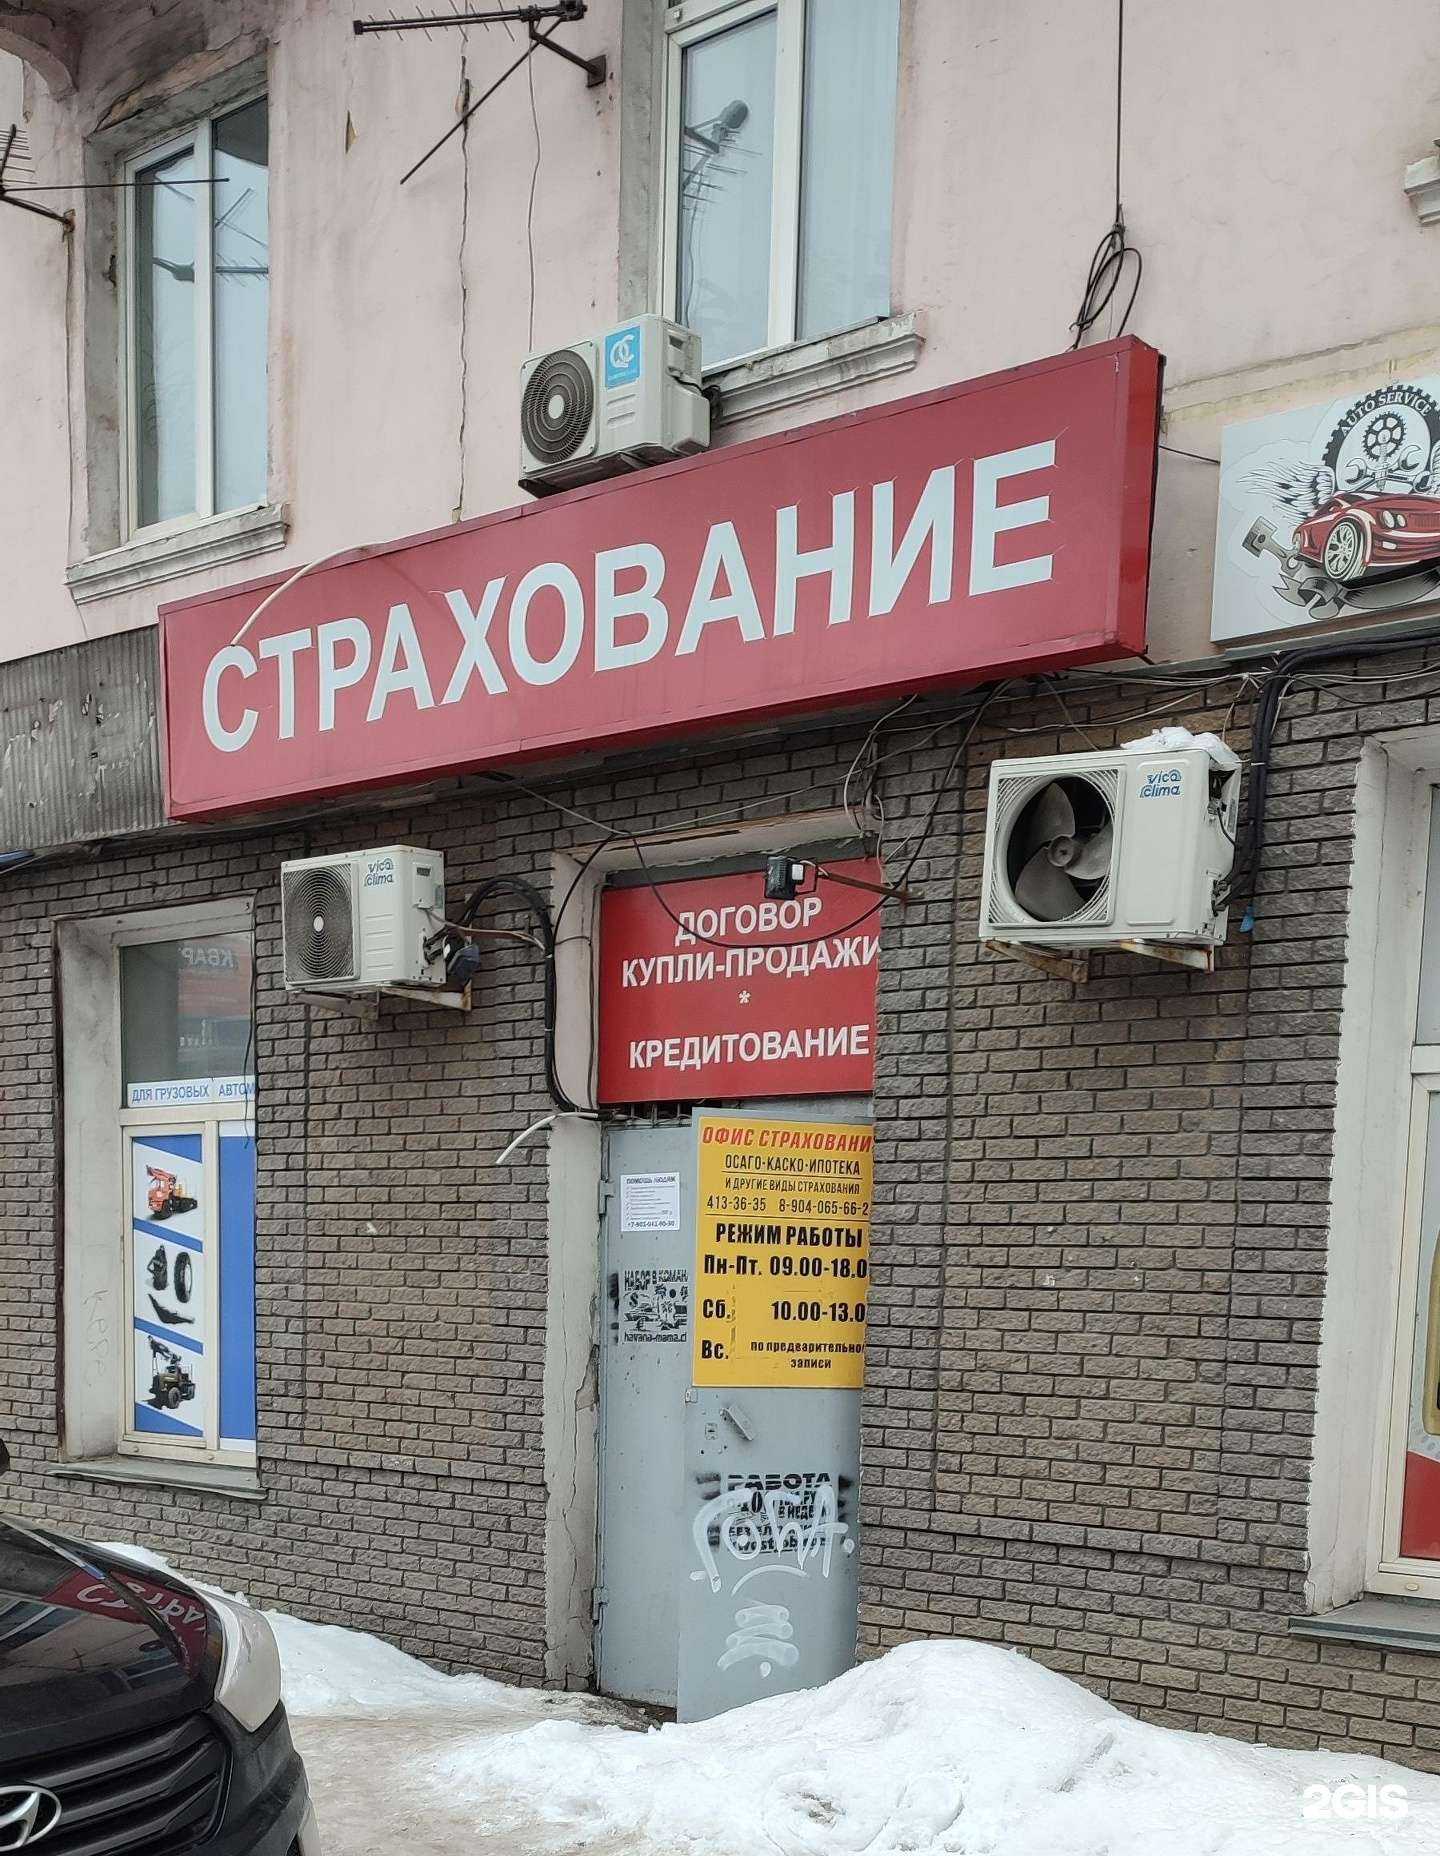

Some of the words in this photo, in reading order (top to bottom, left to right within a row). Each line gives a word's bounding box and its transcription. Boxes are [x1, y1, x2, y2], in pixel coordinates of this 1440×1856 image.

[1341, 400, 1375, 436] AUTO
[1378, 391, 1432, 417] SERVICE
[202, 437, 1057, 753] СТРАХОВАНИЕ
[675, 897, 823, 947] ДОГОВОР
[621, 935, 881, 988] КУПЛИ-ПРОДАЖИ
[629, 1024, 870, 1070] КРЕДИТОВАНИЕ
[132, 1088, 153, 1103] ДЛЯ
[155, 1085, 209, 1100] ГРУЗОВЫХ
[702, 1126, 754, 1147] ОФИС
[725, 1178, 732, 1189] И
[733, 1179, 768, 1191] ДРУГИЕ
[769, 1180, 796, 1192] ВИДЫ
[797, 1181, 860, 1195] СТРАХОВАНИЯ
[707, 1195, 766, 1210] 413-36-35
[716, 1223, 781, 1245] РЕЖИМ
[786, 1226, 863, 1248] РАБОТЫ
[704, 1254, 762, 1276] Пн-Пт.
[770, 1256, 867, 1278] 09.00-18.0
[702, 1298, 731, 1319] Сб.
[701, 1339, 729, 1360] Вс.
[751, 1341, 764, 1351] по
[790, 1358, 832, 1369] записи
